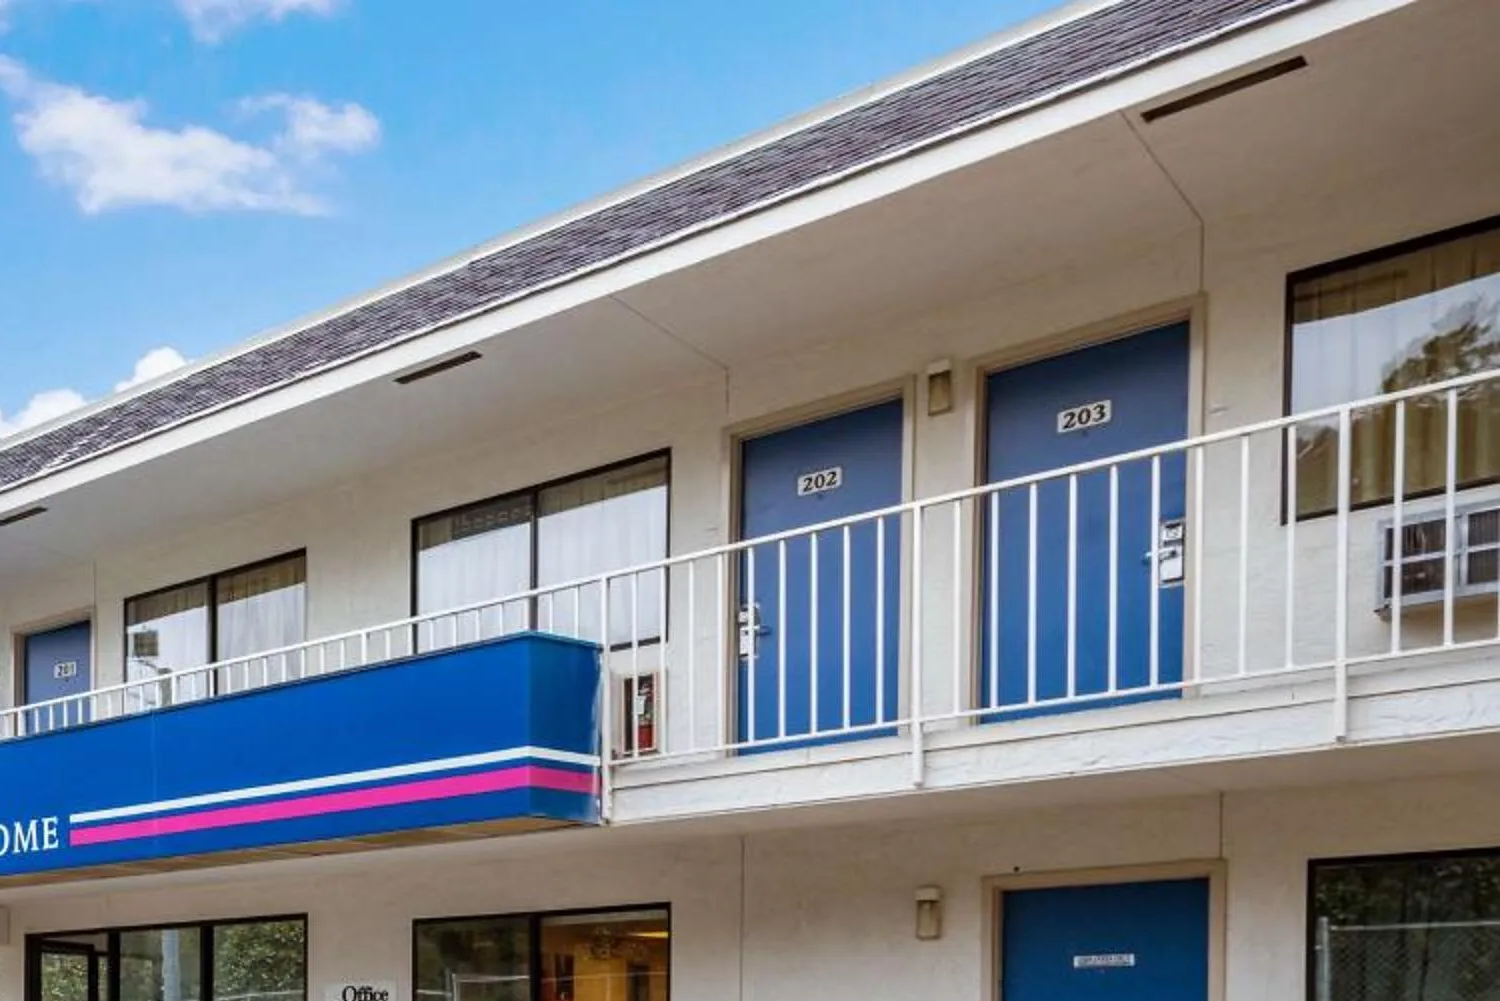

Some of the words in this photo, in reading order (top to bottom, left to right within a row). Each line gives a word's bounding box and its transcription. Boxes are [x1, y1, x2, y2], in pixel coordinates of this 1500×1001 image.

[1063, 404, 1106, 429] 203
[803, 471, 837, 492] 202
[57, 663, 75, 677] 201
